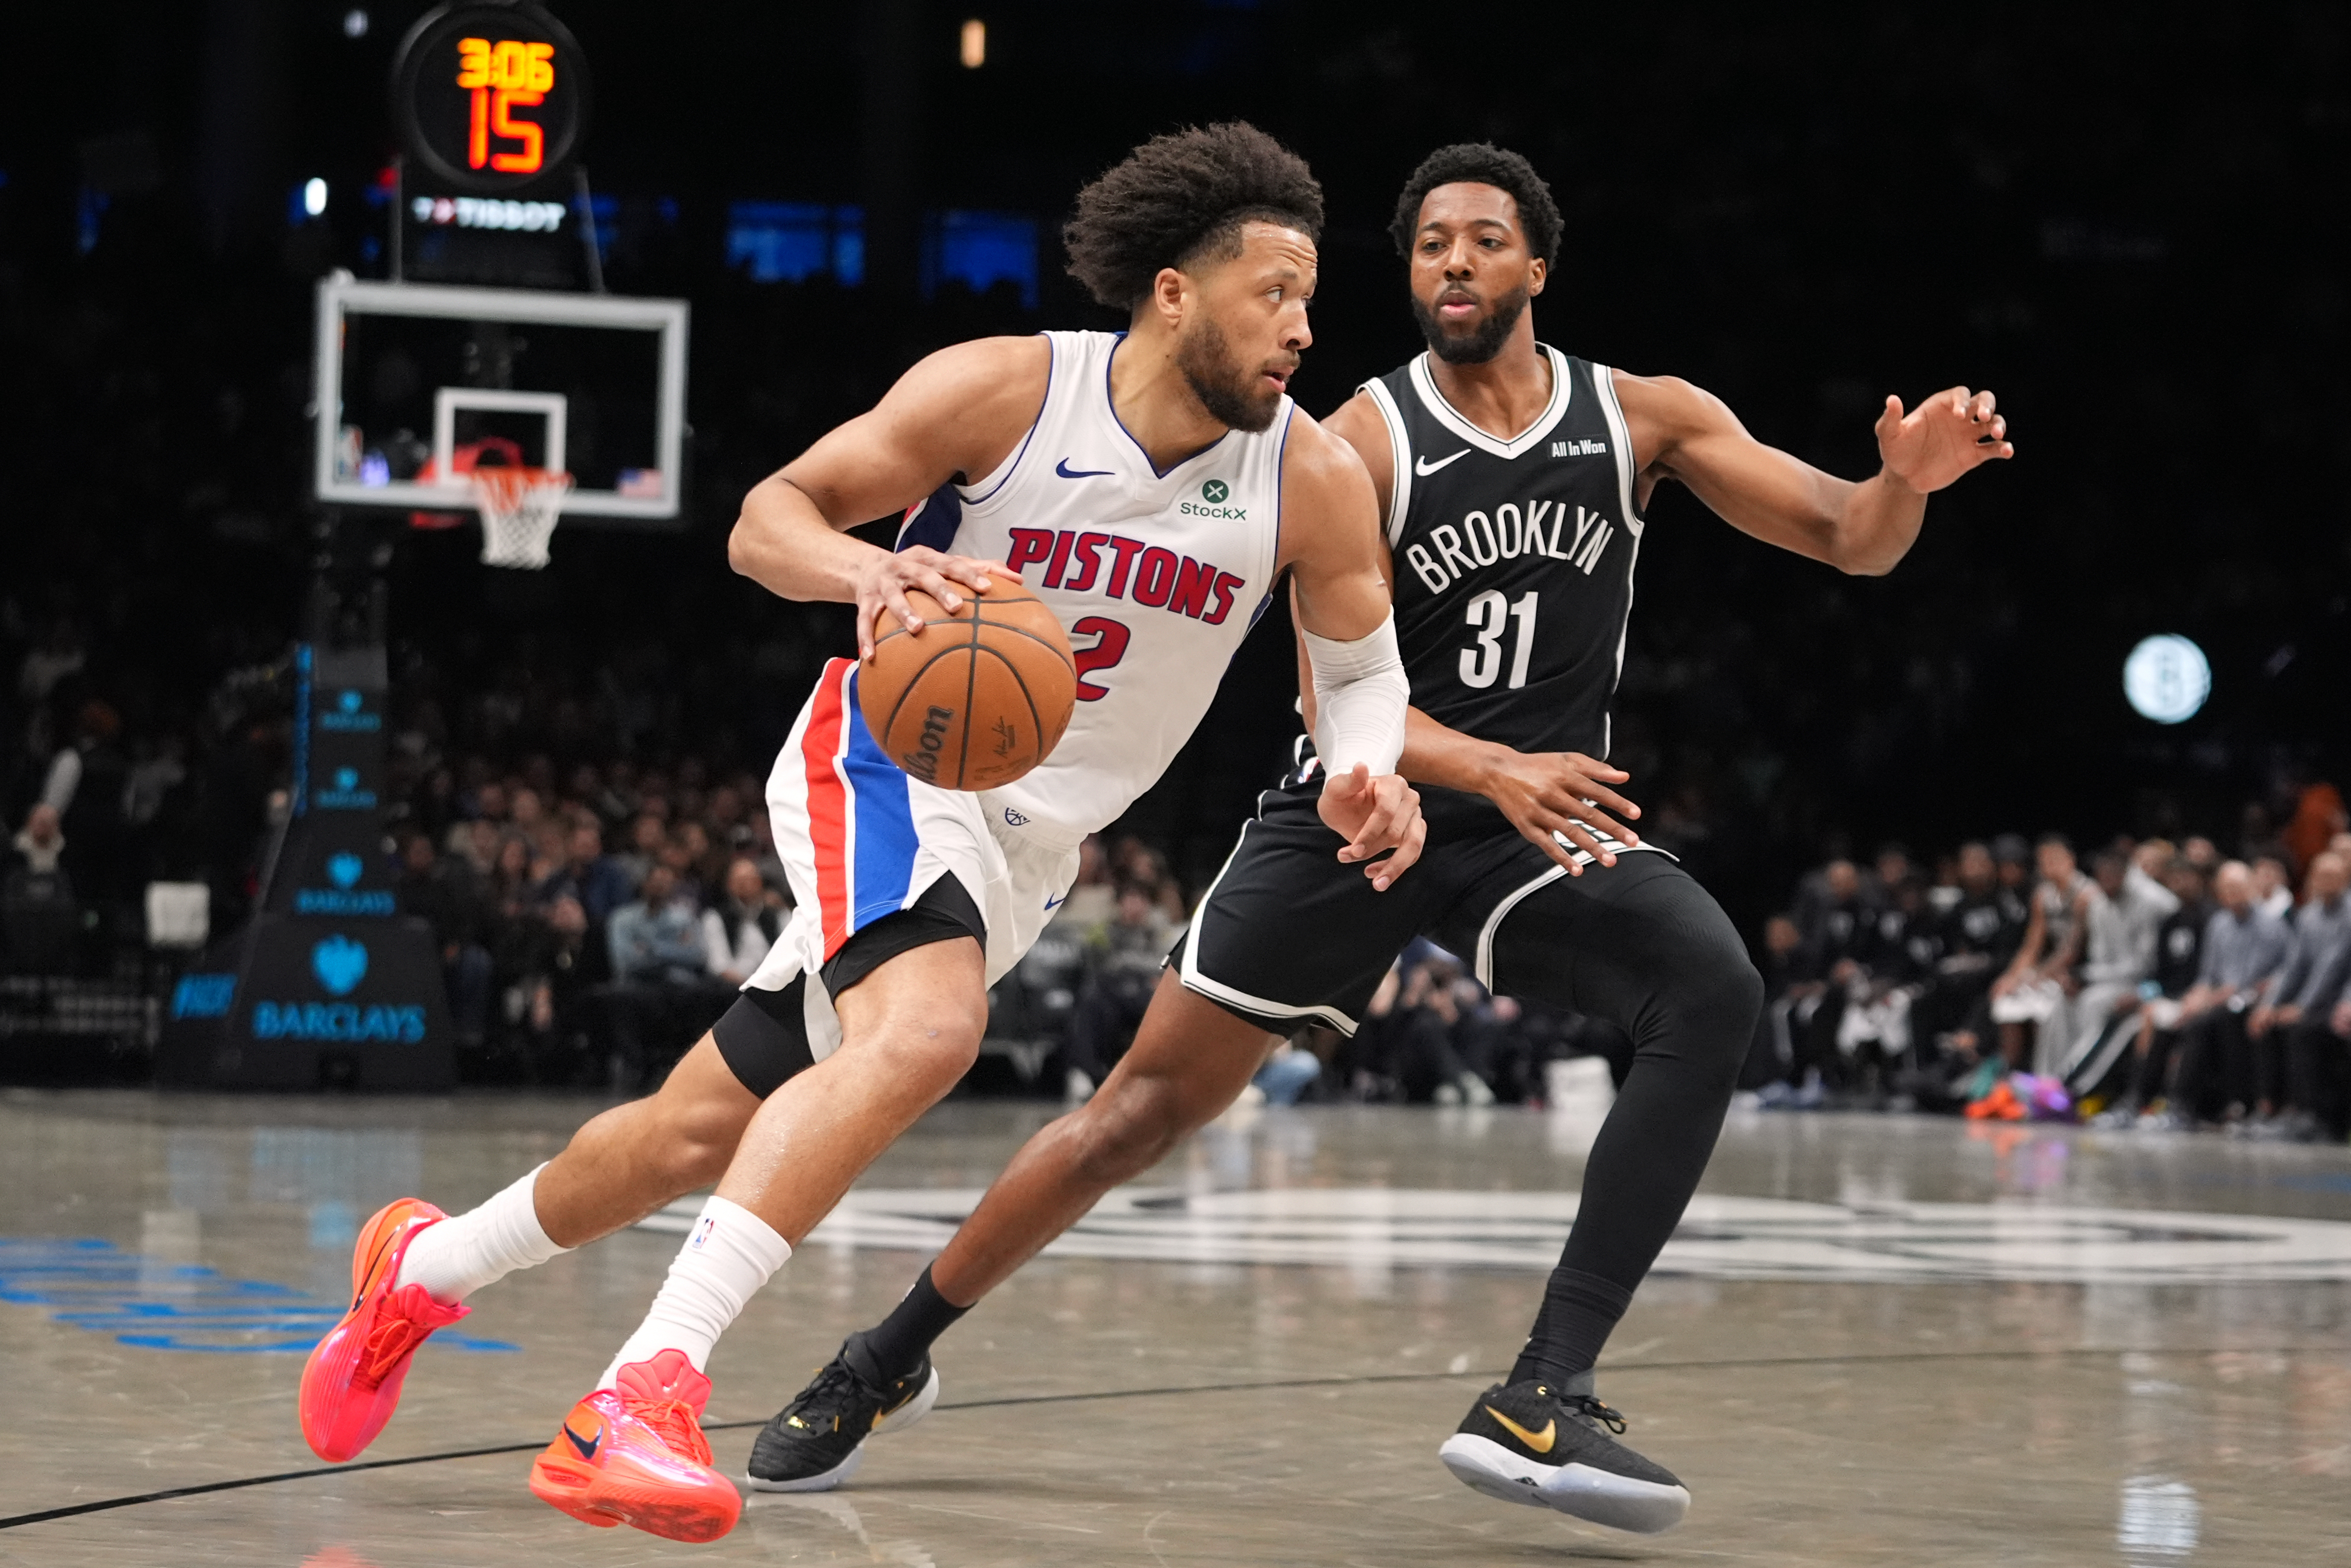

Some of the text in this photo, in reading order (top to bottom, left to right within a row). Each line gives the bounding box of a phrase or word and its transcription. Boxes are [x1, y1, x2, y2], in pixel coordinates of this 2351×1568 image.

[457, 37, 554, 93] 3:06
[469, 87, 545, 173] 15
[1552, 439, 1606, 457] All In Won
[1180, 503, 1247, 521] StockX
[1406, 500, 1614, 595] BROOKLYN
[1007, 527, 1245, 625] PISTONS
[1071, 616, 1131, 702] 2
[1459, 589, 1539, 690] 31
[904, 705, 954, 785] ilson
[253, 1001, 426, 1044] BARCLAYS
